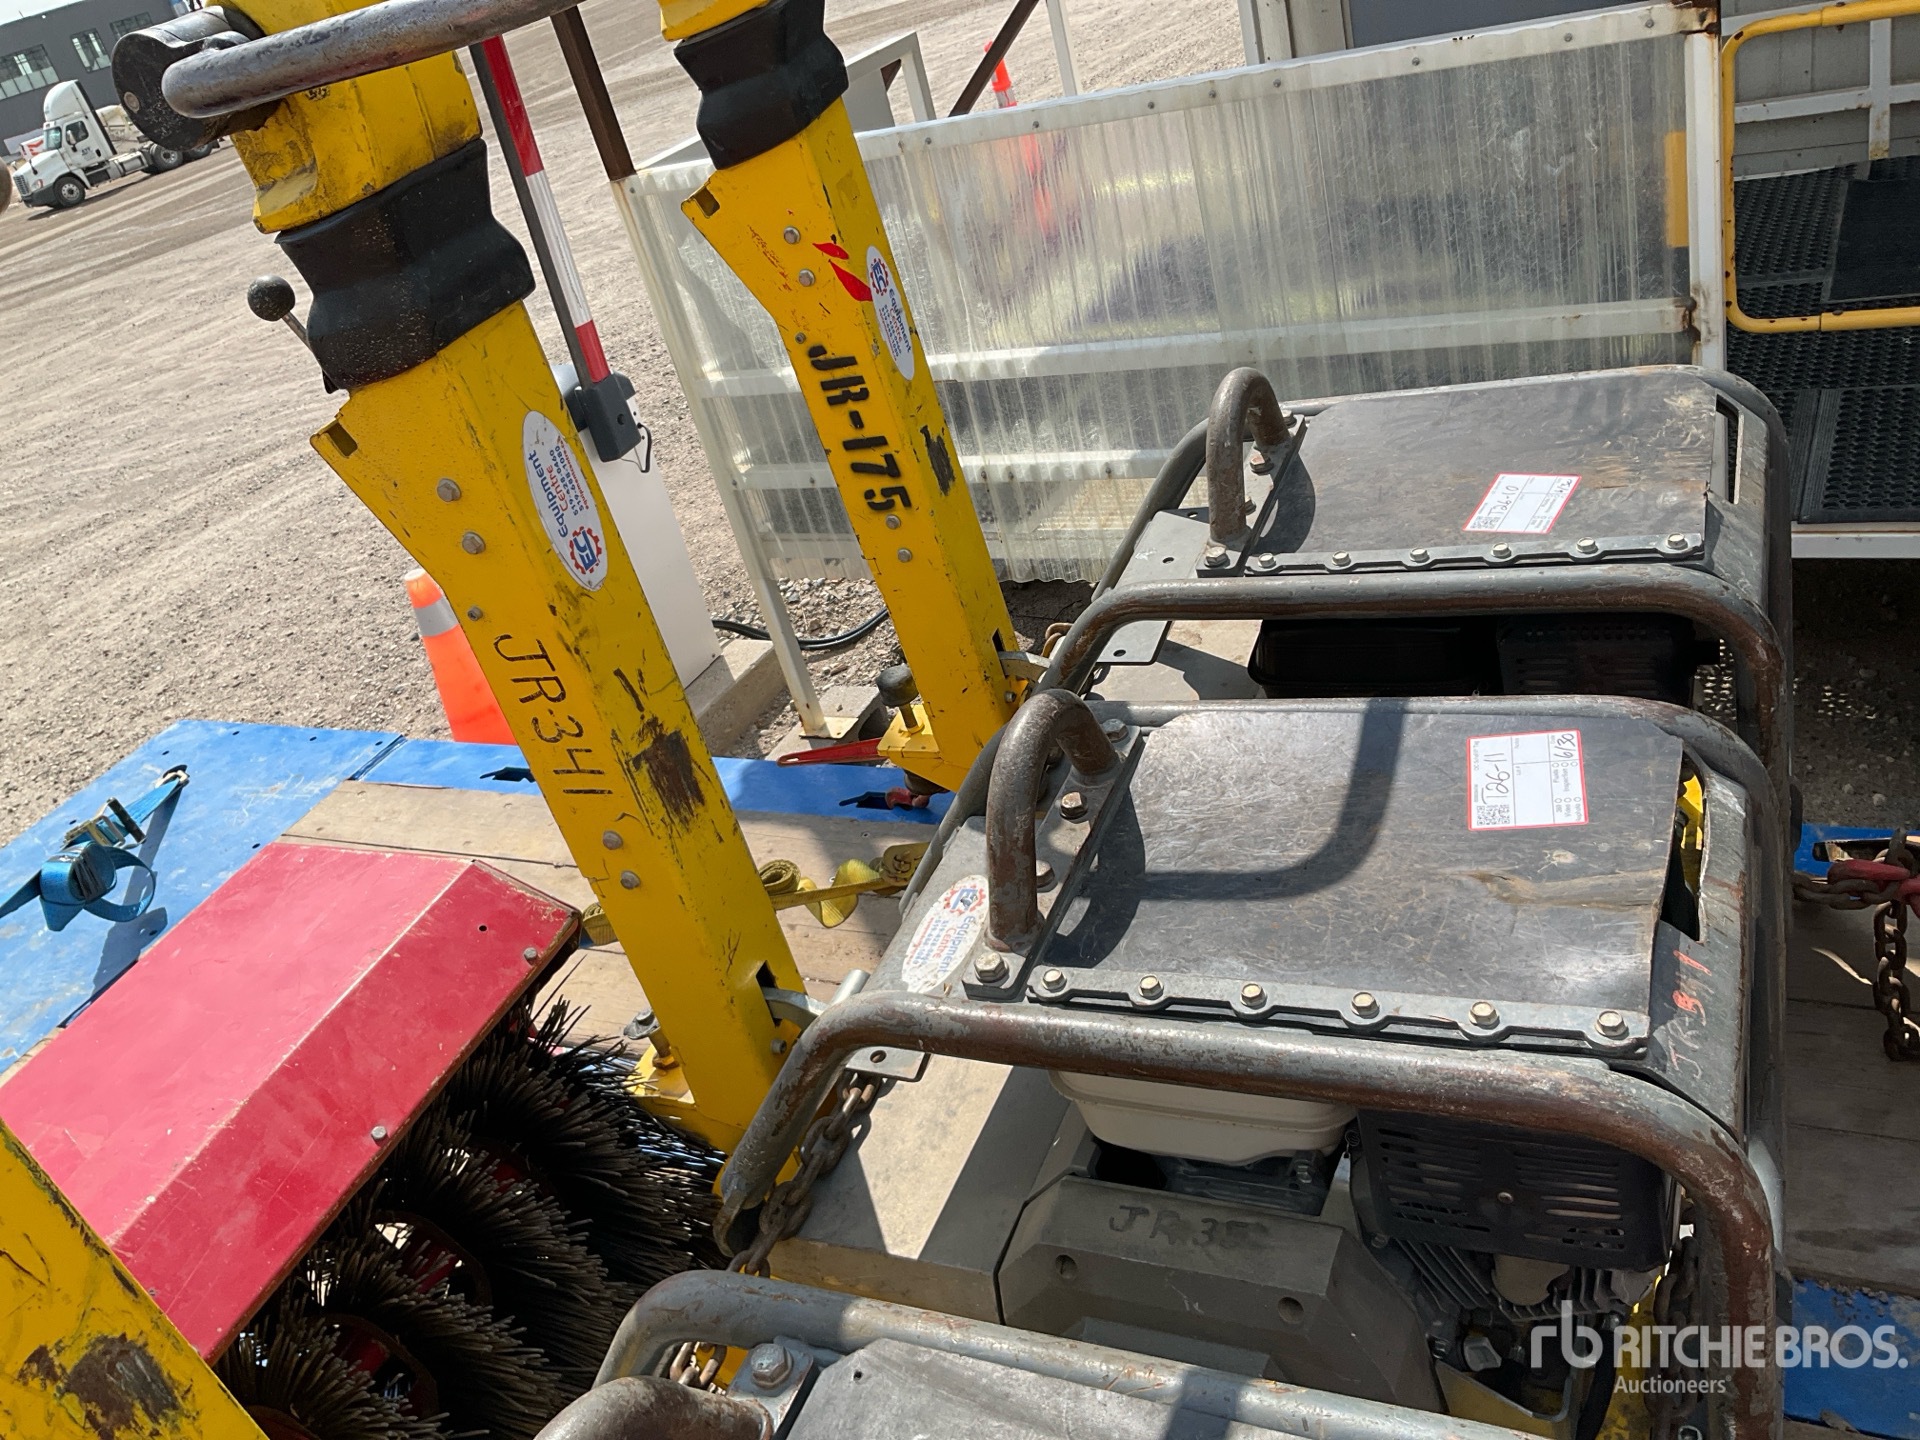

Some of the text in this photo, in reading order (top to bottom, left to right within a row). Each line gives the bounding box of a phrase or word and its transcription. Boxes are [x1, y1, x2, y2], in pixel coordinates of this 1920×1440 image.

[889, 288, 911, 353] Equipment
[890, 308, 903, 343] Centre
[807, 344, 912, 511] JR-175
[528, 450, 569, 538] Equipment
[546, 465, 569, 512] Centre
[550, 449, 579, 516] 519-428-0460
[554, 445, 584, 512] 519-688-1080
[1553, 733, 1577, 758] 6/30
[1481, 752, 1510, 805] T26-11
[933, 927, 957, 959] Centre
[937, 915, 976, 973] Equipment
